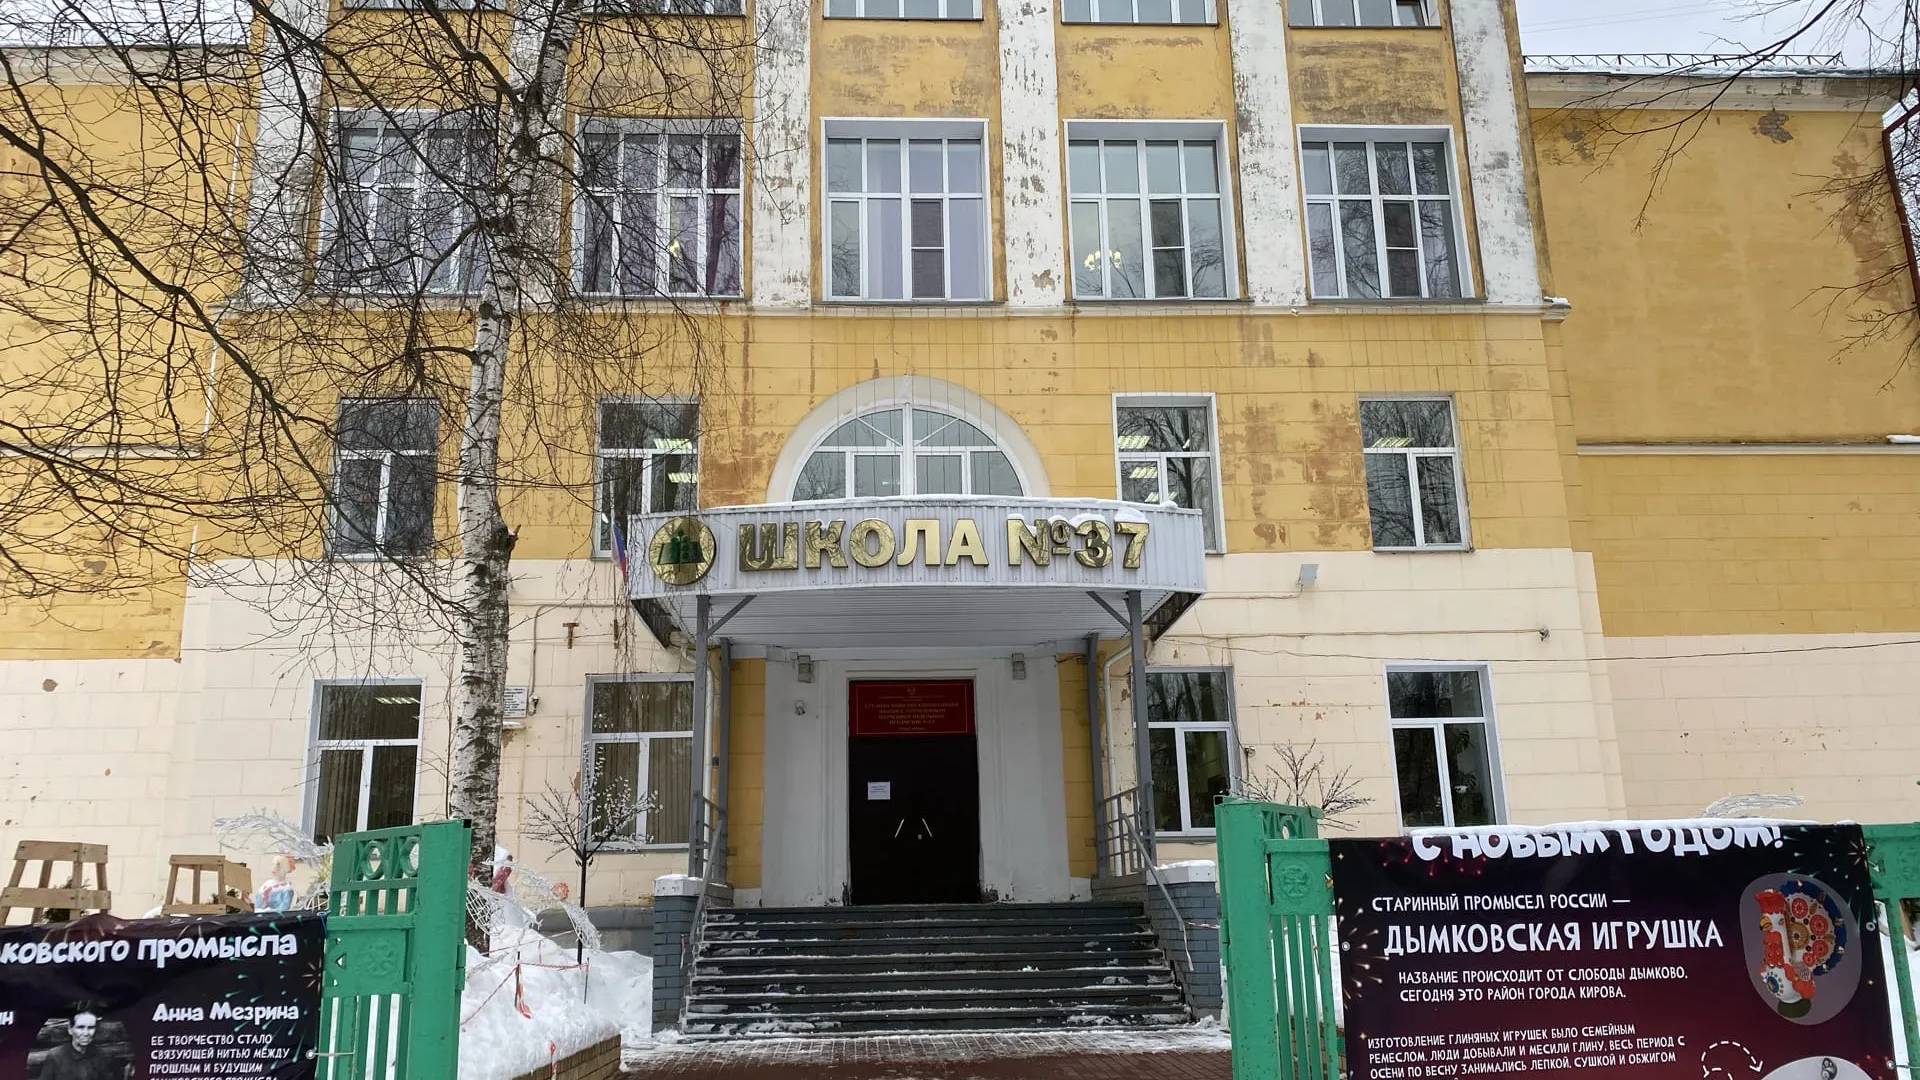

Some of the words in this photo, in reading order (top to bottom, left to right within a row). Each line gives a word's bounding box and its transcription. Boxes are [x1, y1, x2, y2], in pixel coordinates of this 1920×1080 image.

[739, 518, 989, 572] ШКОЛА
[1372, 894, 1459, 911] СТАРИННЫЙ
[1464, 895, 1544, 910] ПРОМЫСЕЛ
[1550, 894, 1607, 908] РОССИИ
[1384, 923, 1580, 956] ДЫМКОВСКАЯ
[1592, 920, 1723, 949] ИГРУШКА
[1399, 971, 1458, 983] НАЗВАНИЕ
[1463, 970, 1542, 983] ПРОИСХОДИТ
[1547, 969, 1564, 981] ОТ
[1569, 968, 1625, 980] СЛОБОДЫ
[1630, 966, 1687, 980] ДЫМКОВО.
[1400, 989, 1454, 1002] СЕГОДНЯ
[1458, 989, 1482, 1000] ЭТО
[1488, 986, 1524, 1000] РАЙОН
[1529, 987, 1575, 999] ГОРОДА
[1580, 986, 1626, 998] КИРОВА.
[152, 1004, 203, 1021] Анна
[210, 1002, 298, 1025] Мезрина
[152, 1036, 164, 1045] ЕЕ
[168, 1035, 234, 1045] ТВОРЧЕСТВО
[238, 1034, 272, 1044] СТАЛО
[1368, 1035, 1445, 1048] ИЗГОТОВЛЕНИЕ
[1449, 1032, 1499, 1044] ГЛИНЯНЫХ
[1503, 1029, 1547, 1041] ИГРУШЕК
[1552, 1028, 1578, 1038] БЫЛО
[1582, 1023, 1635, 1036] СЕМЕЙНЫМ
[151, 1047, 214, 1059] СВЯЗУЮЩЕЙ
[217, 1049, 250, 1058] НИТЬЮ
[253, 1046, 289, 1058] МЕЖДУ
[1370, 1052, 1427, 1063] РЕМЕСЛОМ.
[1430, 1049, 1459, 1060] ЛЮДИ
[1463, 1046, 1515, 1059] ДОБЫВАЛИ
[1519, 1046, 1525, 1055] И
[1530, 1043, 1569, 1055] МЕСИЛИ
[1610, 1039, 1633, 1050] ВЕСЬ
[1637, 1037, 1674, 1048] ПЕРИОД
[1678, 1036, 1685, 1045] С
[150, 1064, 200, 1073] ПРОШЛЫМ
[204, 1064, 210, 1072] И
[214, 1063, 262, 1073] БУДУЩИМ
[1371, 1067, 1404, 1079] ОСЕНИ
[1408, 1067, 1422, 1077] ПО
[1426, 1064, 1457, 1076] ВЕСНУ
[1461, 1061, 1526, 1074] ЗАНИМАЛИСЬ
[1574, 1054, 1615, 1067] СУШКОЙ
[1619, 1055, 1625, 1064] И
[1629, 1052, 1676, 1064] ОБЖИГОМ
